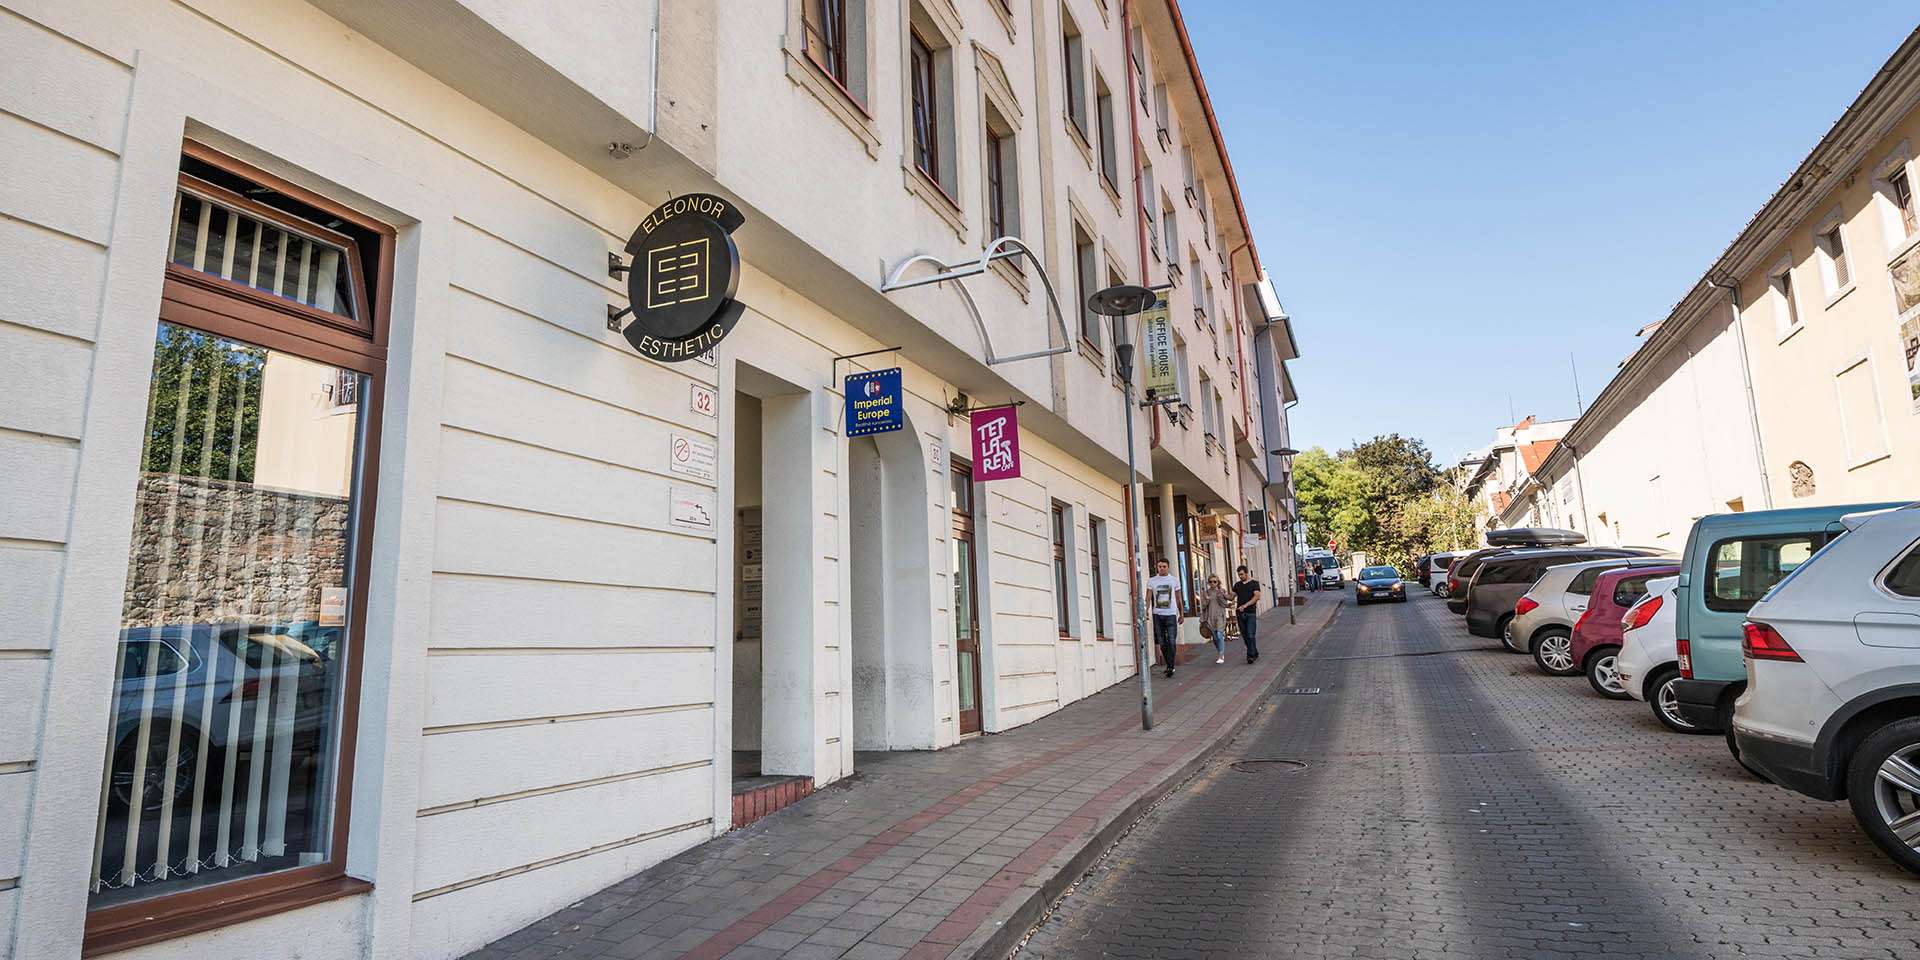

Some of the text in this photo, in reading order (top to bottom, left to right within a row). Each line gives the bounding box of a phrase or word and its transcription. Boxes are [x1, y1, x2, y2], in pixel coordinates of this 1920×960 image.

[642, 197, 725, 234] ELEONOR
[639, 323, 724, 357] ESTHETIC
[1155, 316, 1167, 347] OFFICE
[1158, 348, 1170, 377] HOUSE
[697, 392, 710, 411] 32
[854, 394, 893, 409] Imperial
[857, 408, 890, 420] Europe
[977, 416, 1007, 440] TEP
[983, 446, 1013, 474] REN
